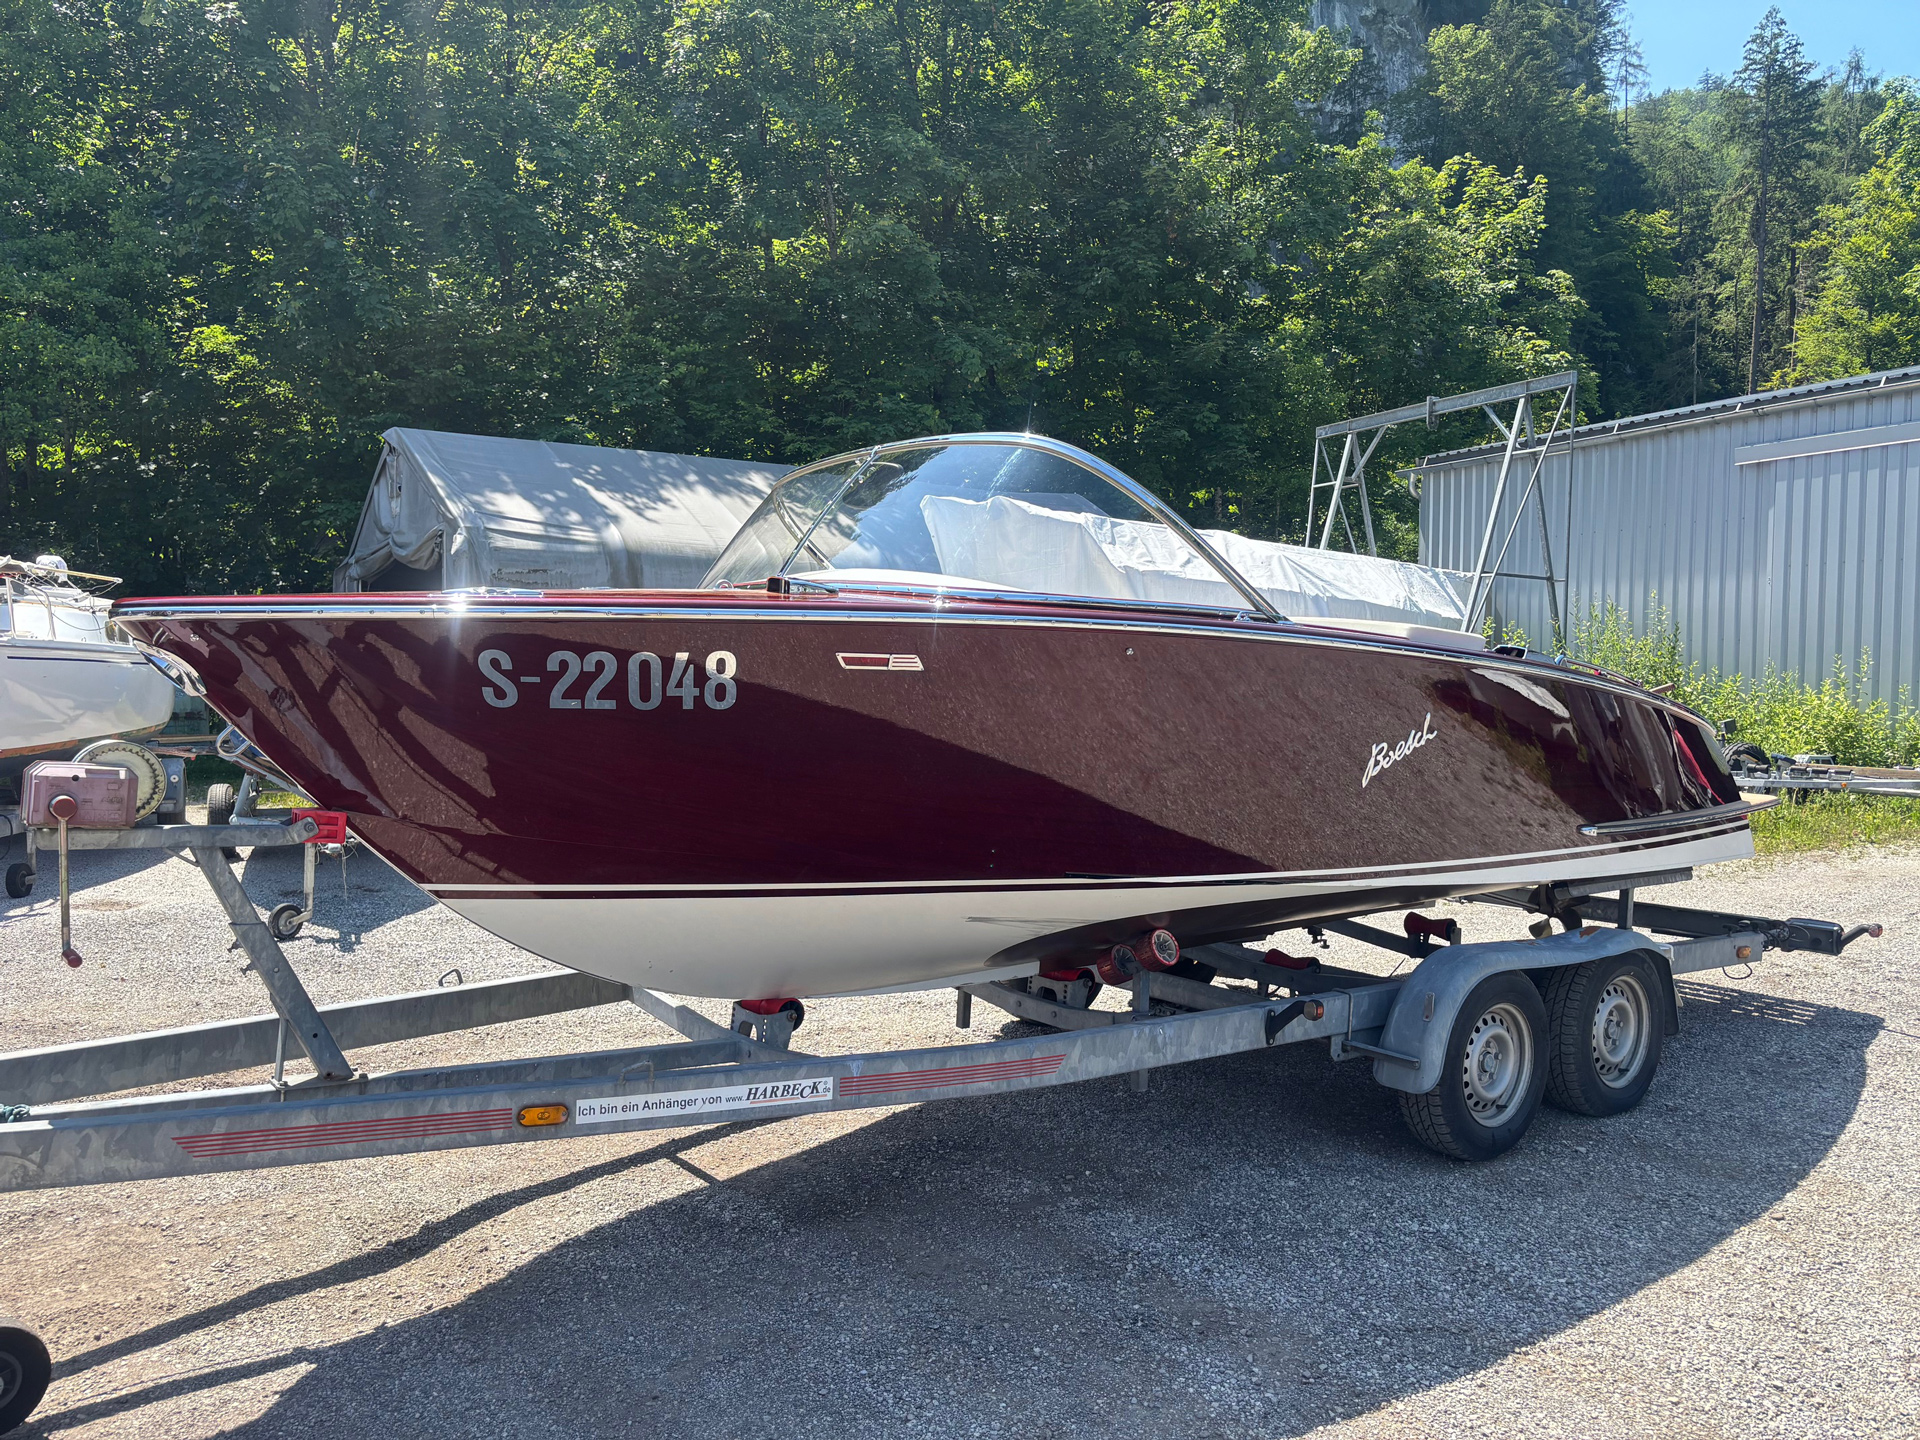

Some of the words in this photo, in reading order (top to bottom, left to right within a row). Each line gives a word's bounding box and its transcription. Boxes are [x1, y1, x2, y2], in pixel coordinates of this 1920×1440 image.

[1362, 712, 1437, 788] Boesch
[578, 1105, 596, 1117] Ich
[600, 1104, 618, 1115] bin
[621, 1101, 639, 1112] ein
[642, 1098, 699, 1111] Anhänger
[701, 1095, 722, 1105] von
